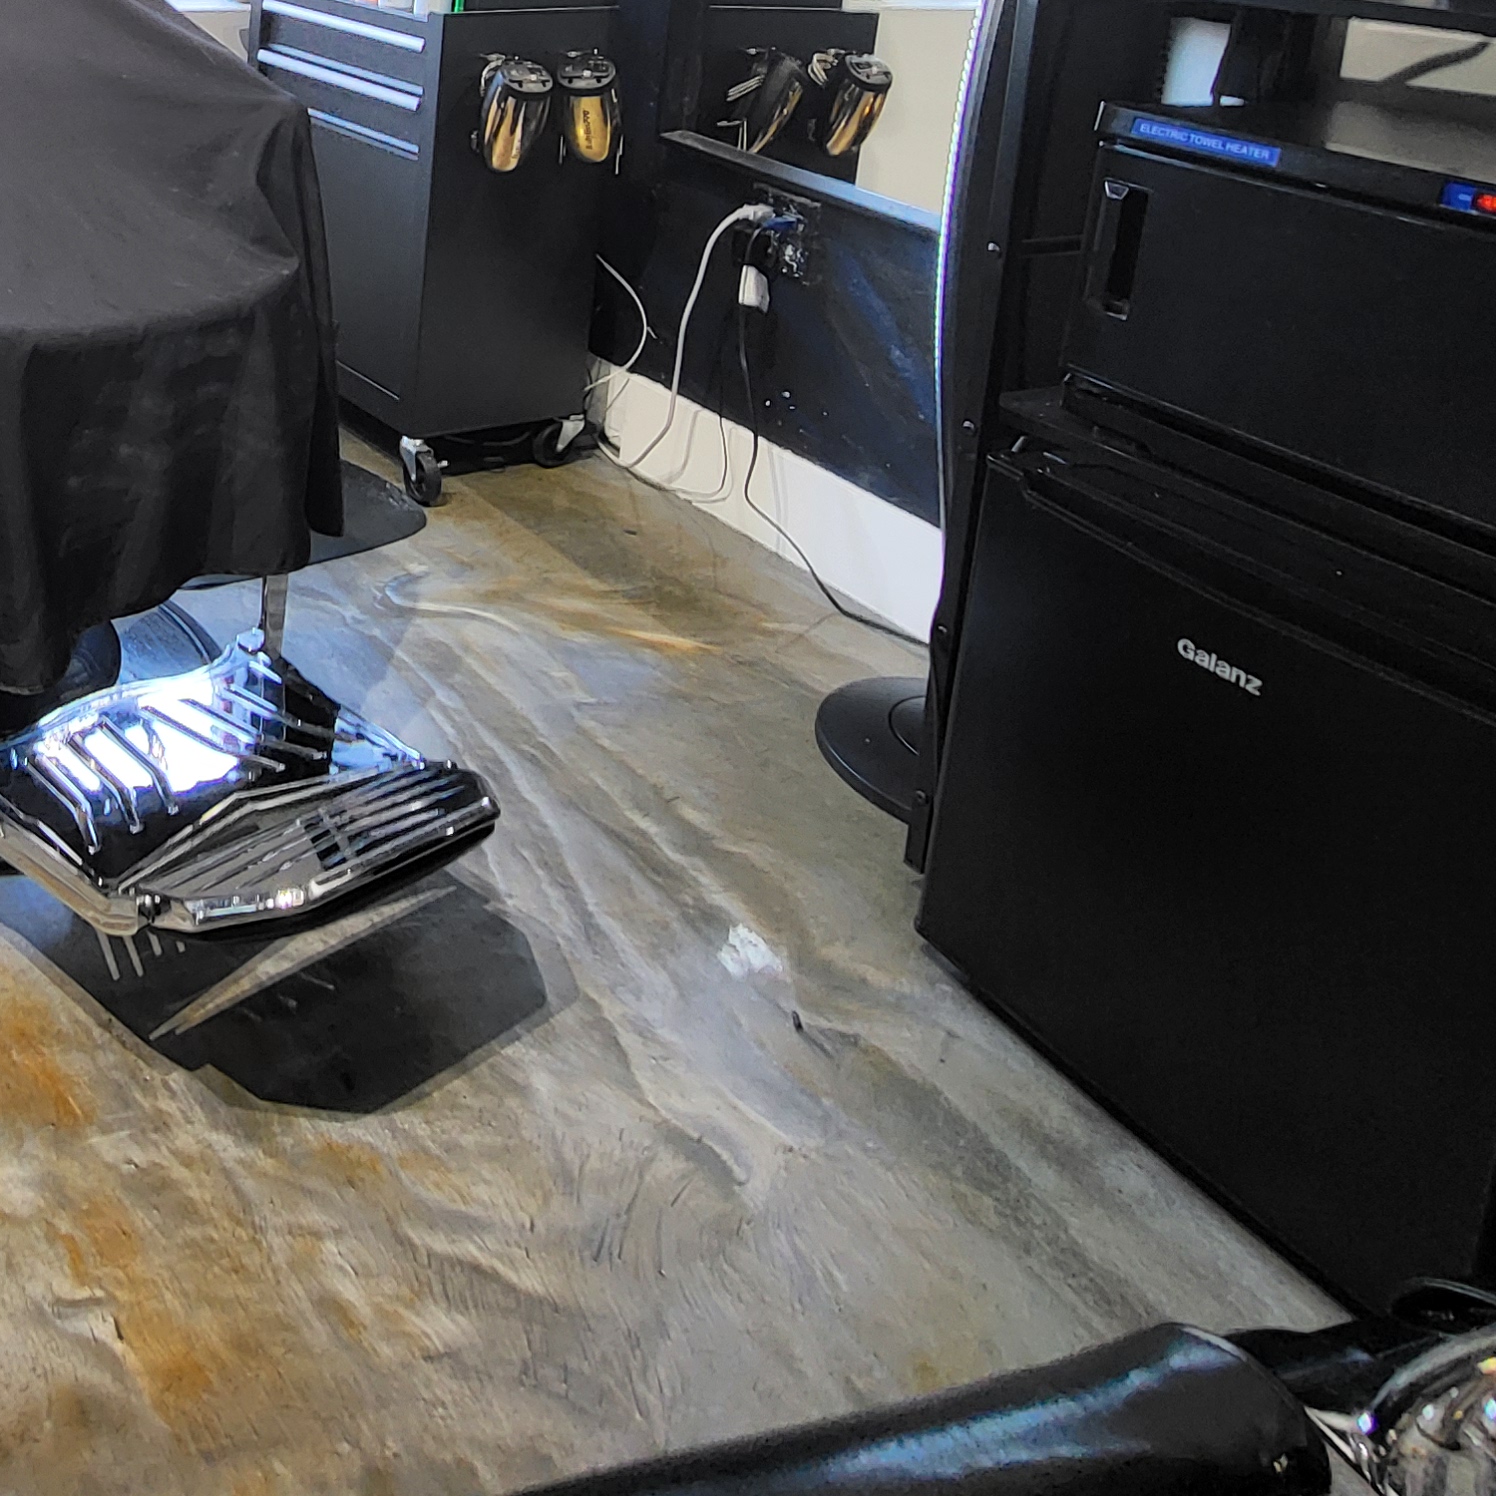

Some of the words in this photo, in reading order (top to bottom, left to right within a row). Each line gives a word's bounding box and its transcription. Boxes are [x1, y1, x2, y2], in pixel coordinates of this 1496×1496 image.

[1139, 123, 1189, 142] ELECTRIC
[1189, 134, 1224, 150] TOWEL
[1225, 142, 1270, 160] HEATER
[1177, 637, 1264, 697] Galanz
